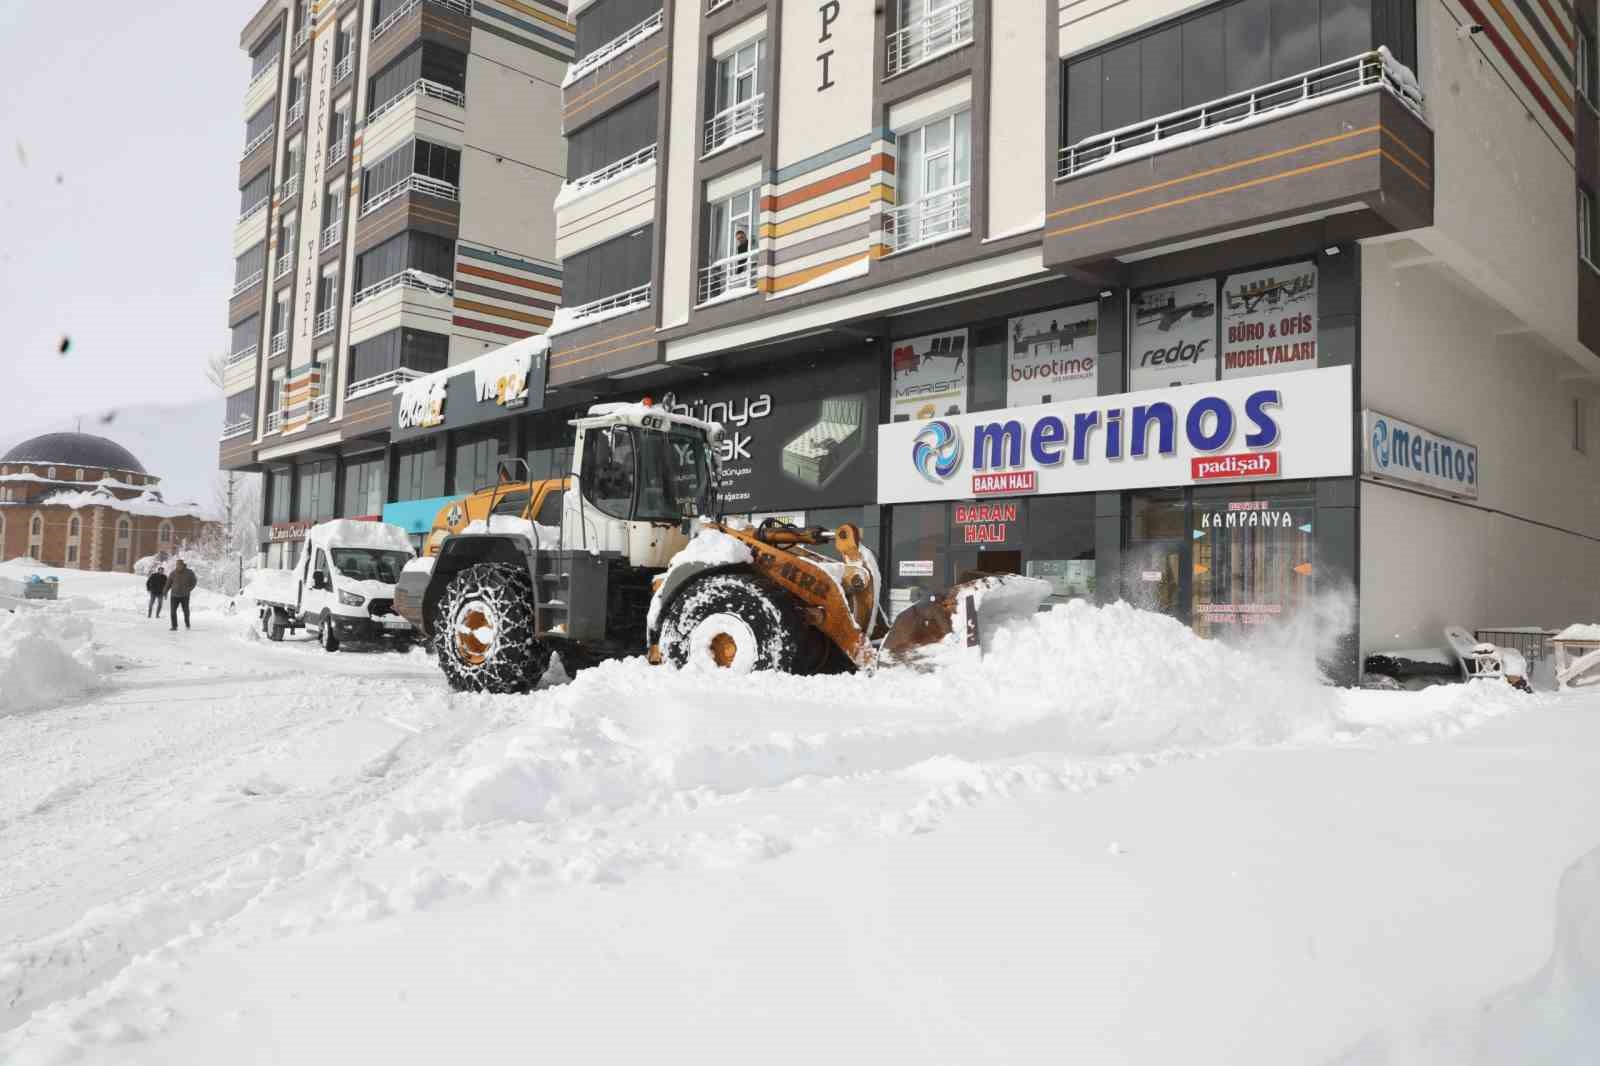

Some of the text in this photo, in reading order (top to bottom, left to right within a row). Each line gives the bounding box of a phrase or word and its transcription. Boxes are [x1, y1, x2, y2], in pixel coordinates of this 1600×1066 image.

[1228, 312, 1313, 344] BÜRO & OFİS
[1224, 341, 1316, 370] MOBİLYALARI
[1011, 357, 1095, 382] bürotime
[972, 389, 1281, 470] merinos
[1198, 455, 1271, 477] padişah
[1392, 427, 1475, 485] merinos
[974, 473, 1033, 492] BARAN HALI
[955, 503, 1017, 523] BARAN
[1201, 511, 1293, 528] KAMPANYA
[964, 523, 1007, 543] HALI
